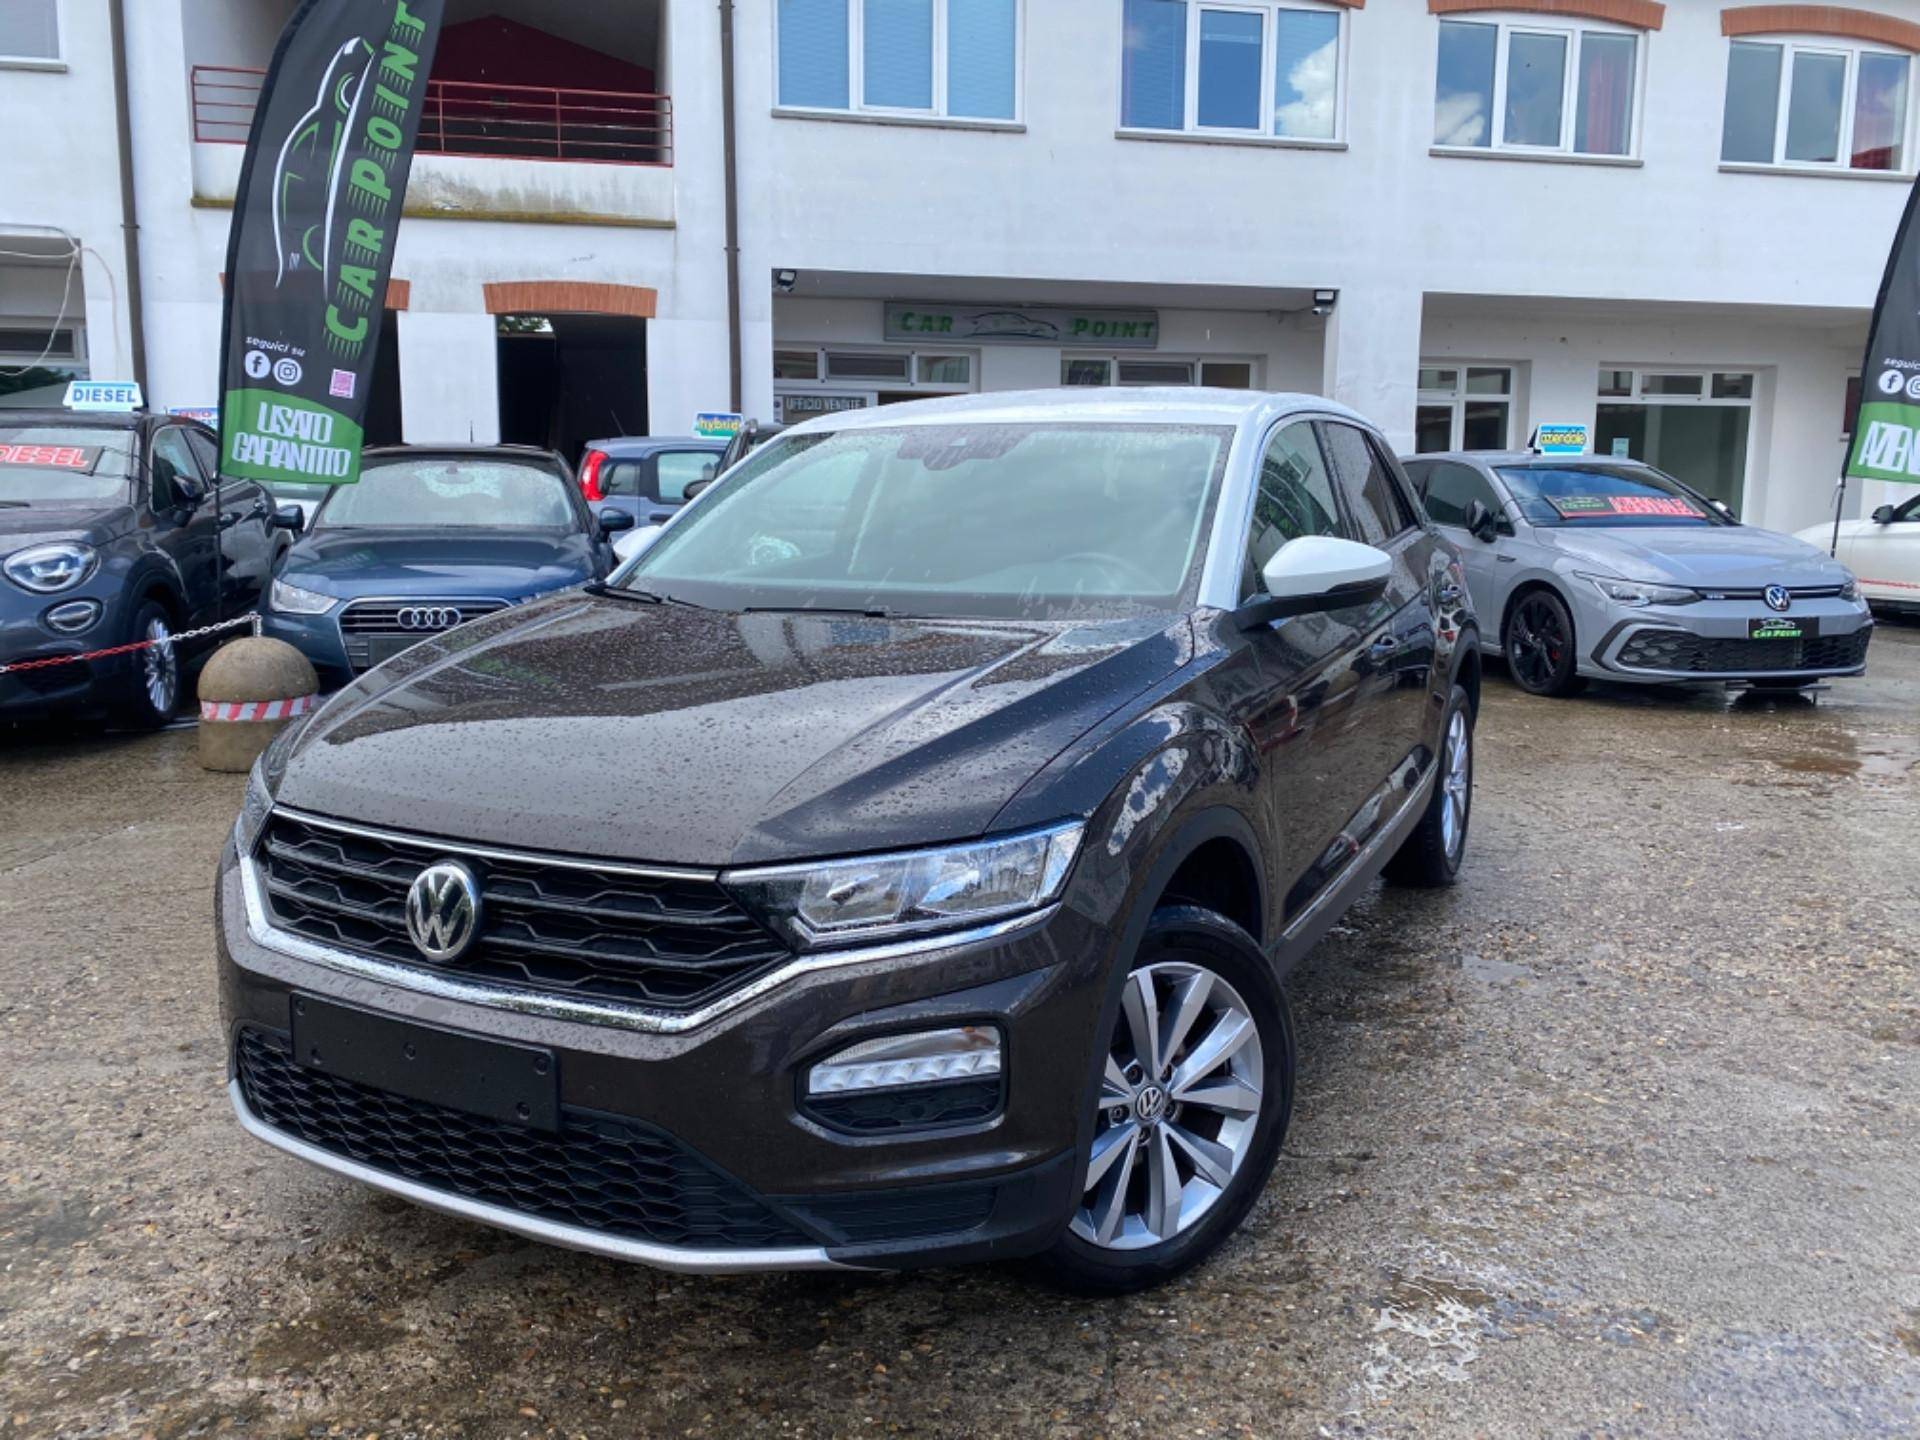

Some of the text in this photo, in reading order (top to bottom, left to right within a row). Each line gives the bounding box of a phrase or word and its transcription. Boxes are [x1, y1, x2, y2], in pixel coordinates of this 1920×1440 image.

[324, 0, 426, 343] CAR POINT
[899, 311, 1156, 338] CAR POINT
[73, 388, 137, 403] DIESEL
[786, 397, 862, 410] UFFICIO VENDITE
[257, 401, 333, 444] USATO
[699, 416, 741, 431] hybrid
[231, 432, 351, 478] GARANTITO
[1751, 629, 1803, 638] CAR POINT
